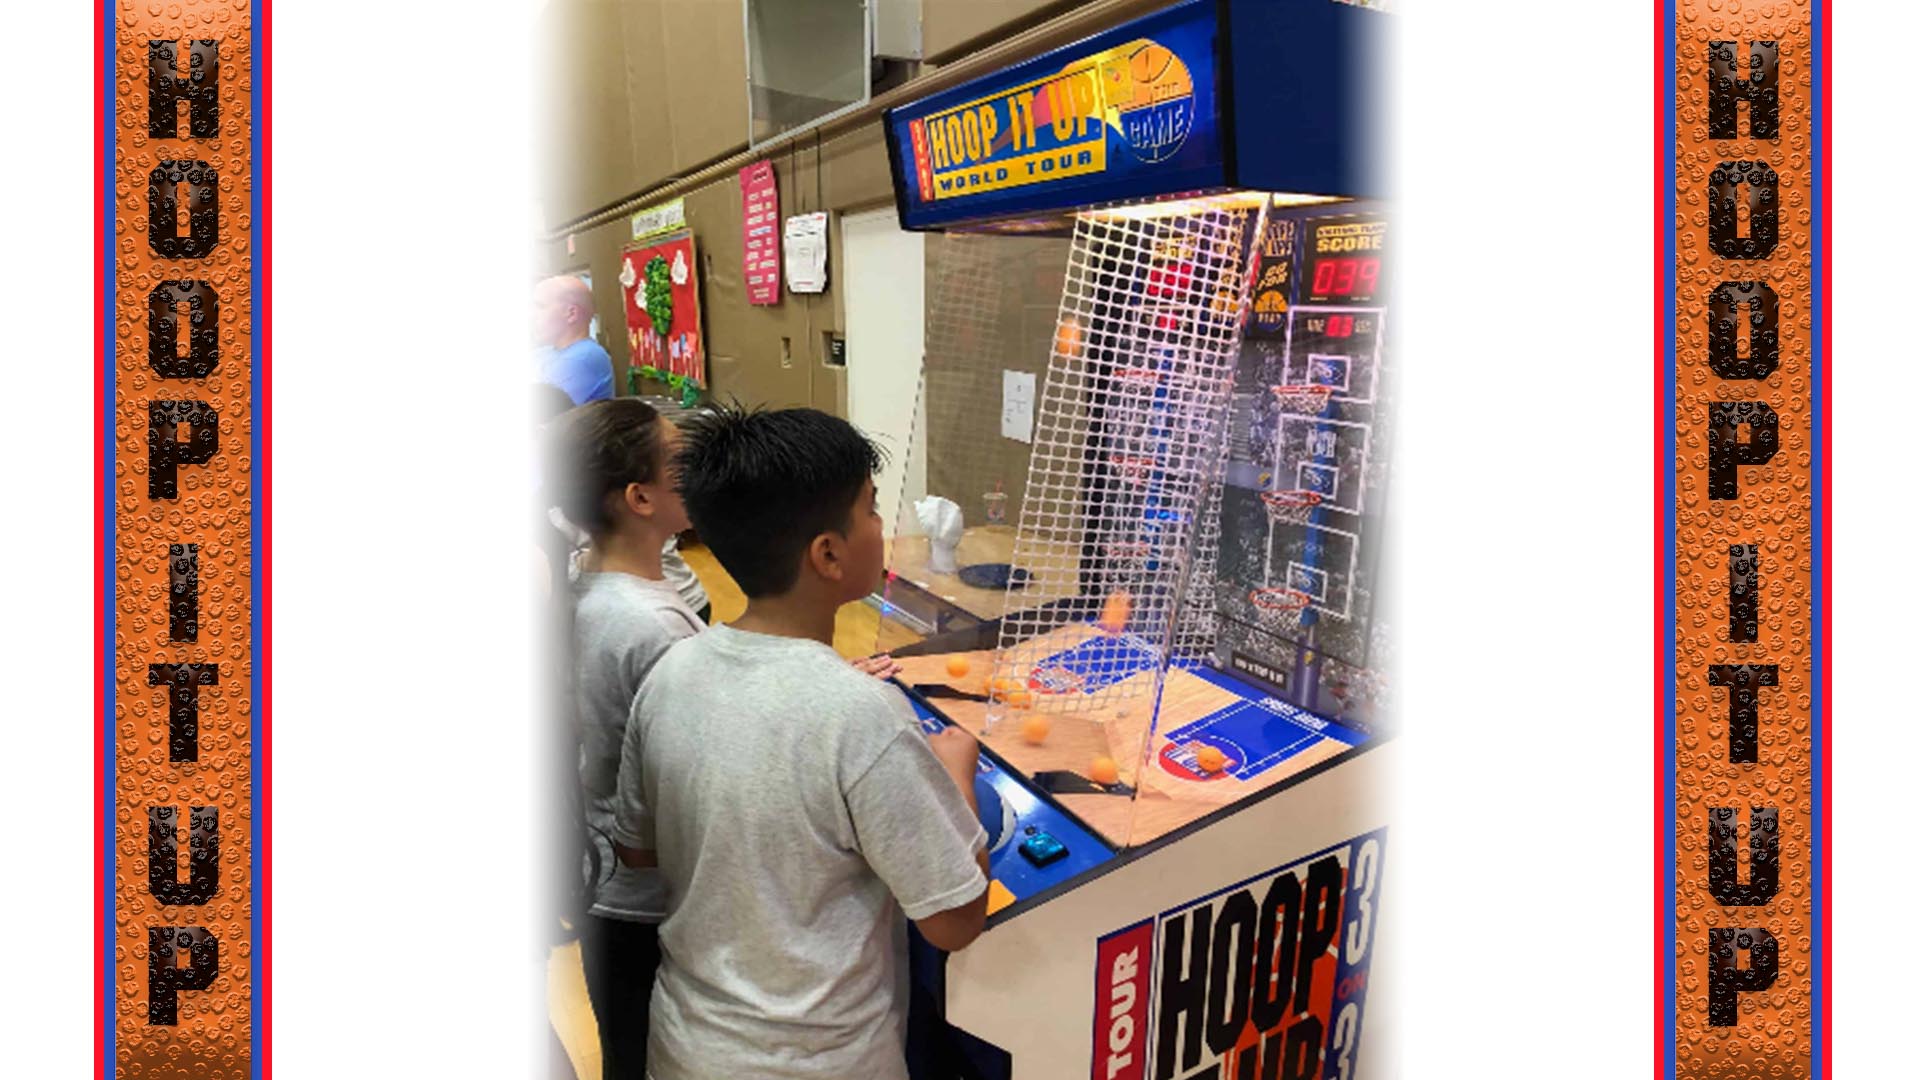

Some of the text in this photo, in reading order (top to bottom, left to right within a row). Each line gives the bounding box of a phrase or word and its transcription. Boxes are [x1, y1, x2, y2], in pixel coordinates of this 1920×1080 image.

[929, 104, 999, 170] HOOP
[1007, 90, 1037, 151] IT
[1047, 73, 1096, 142] UP
[1130, 103, 1185, 149] GAME
[939, 150, 1093, 192] WORLD TOUR
[1316, 234, 1383, 253] SCORE
[1312, 257, 1381, 296] 039
[1347, 839, 1379, 965] 3
[1157, 854, 1343, 1080] HOOP
[1338, 971, 1368, 1000] ON
[1107, 945, 1139, 1080] TOUR
